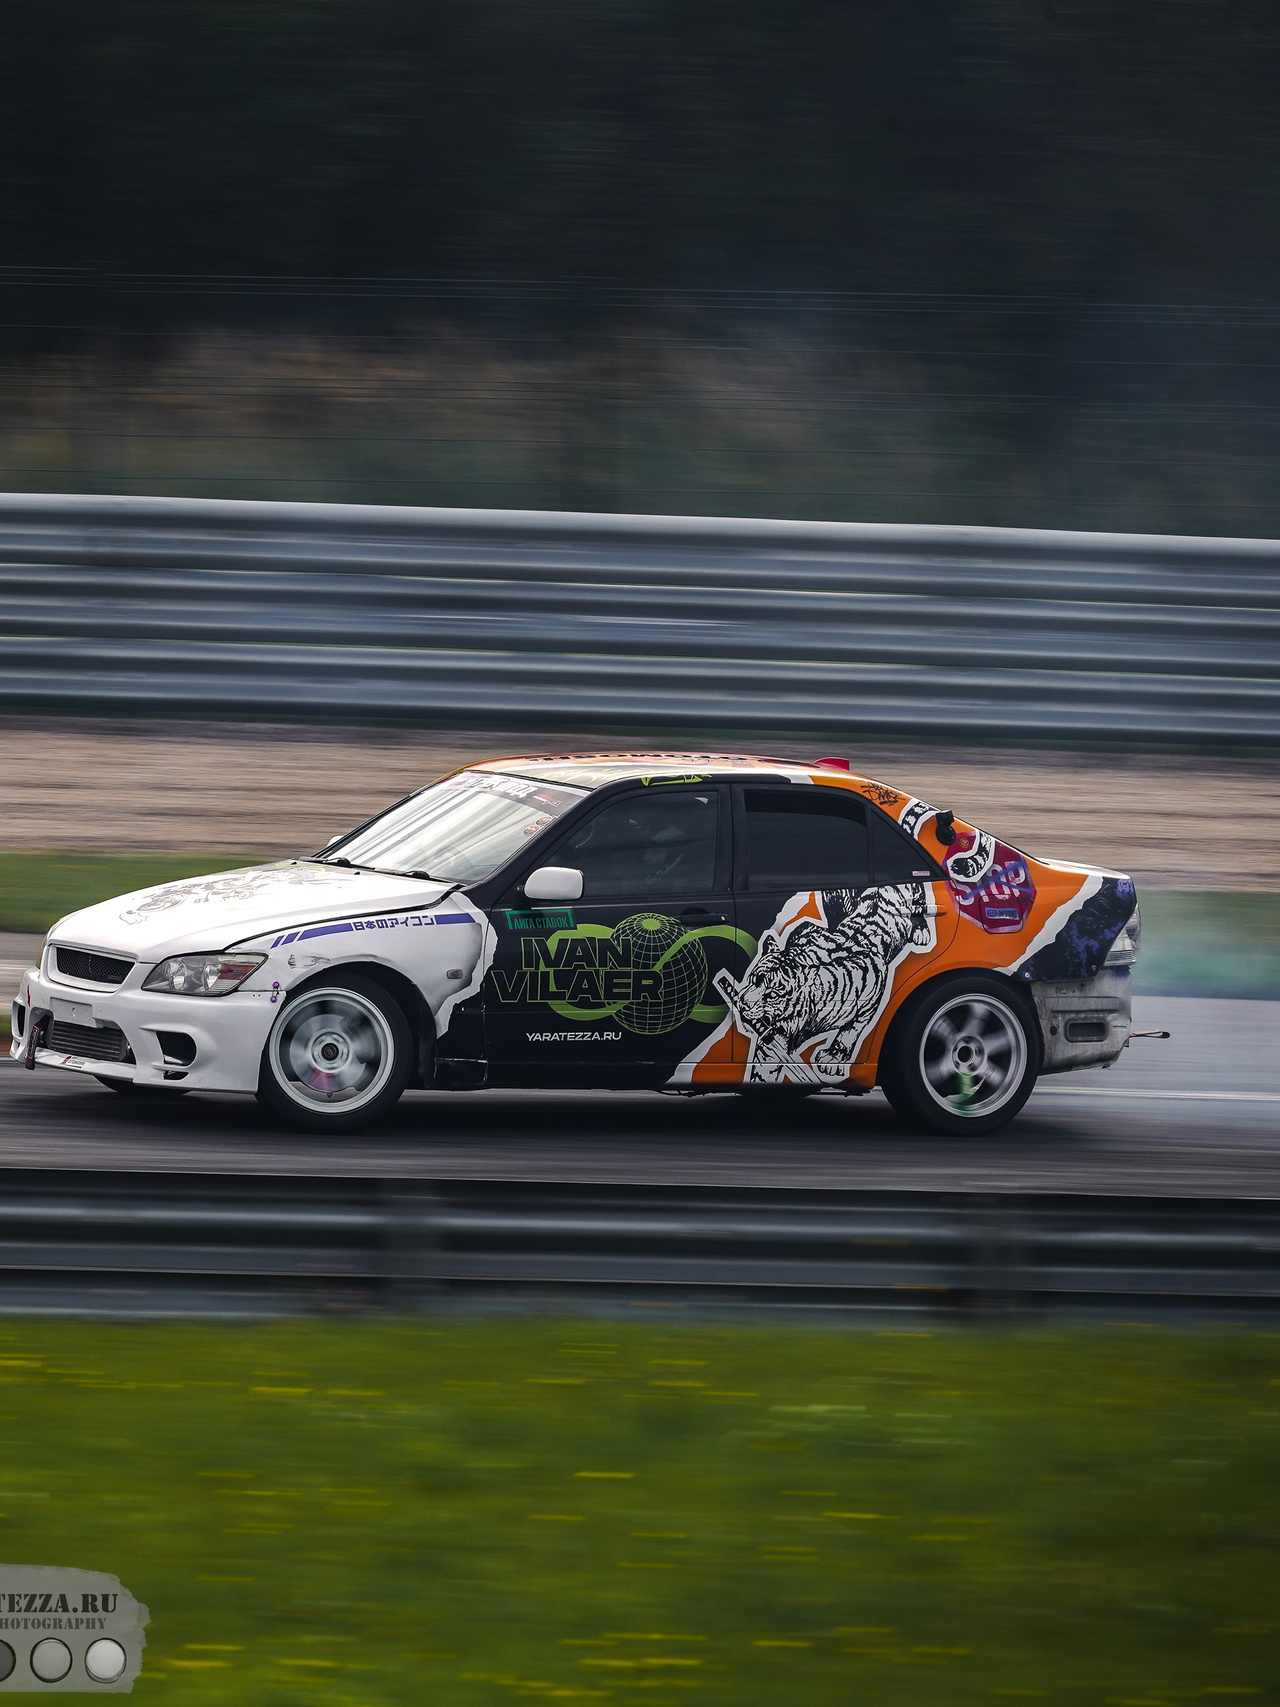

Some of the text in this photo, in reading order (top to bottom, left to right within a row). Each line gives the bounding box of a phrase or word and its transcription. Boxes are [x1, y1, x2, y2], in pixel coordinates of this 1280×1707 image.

[353, 915, 435, 931] 日本のアイコン
[514, 916, 569, 930] ЛИГА СТАВОК
[521, 937, 632, 969] IVAN
[491, 969, 664, 1002] VILAER
[526, 1031, 622, 1042] YARATEZZA.RU
